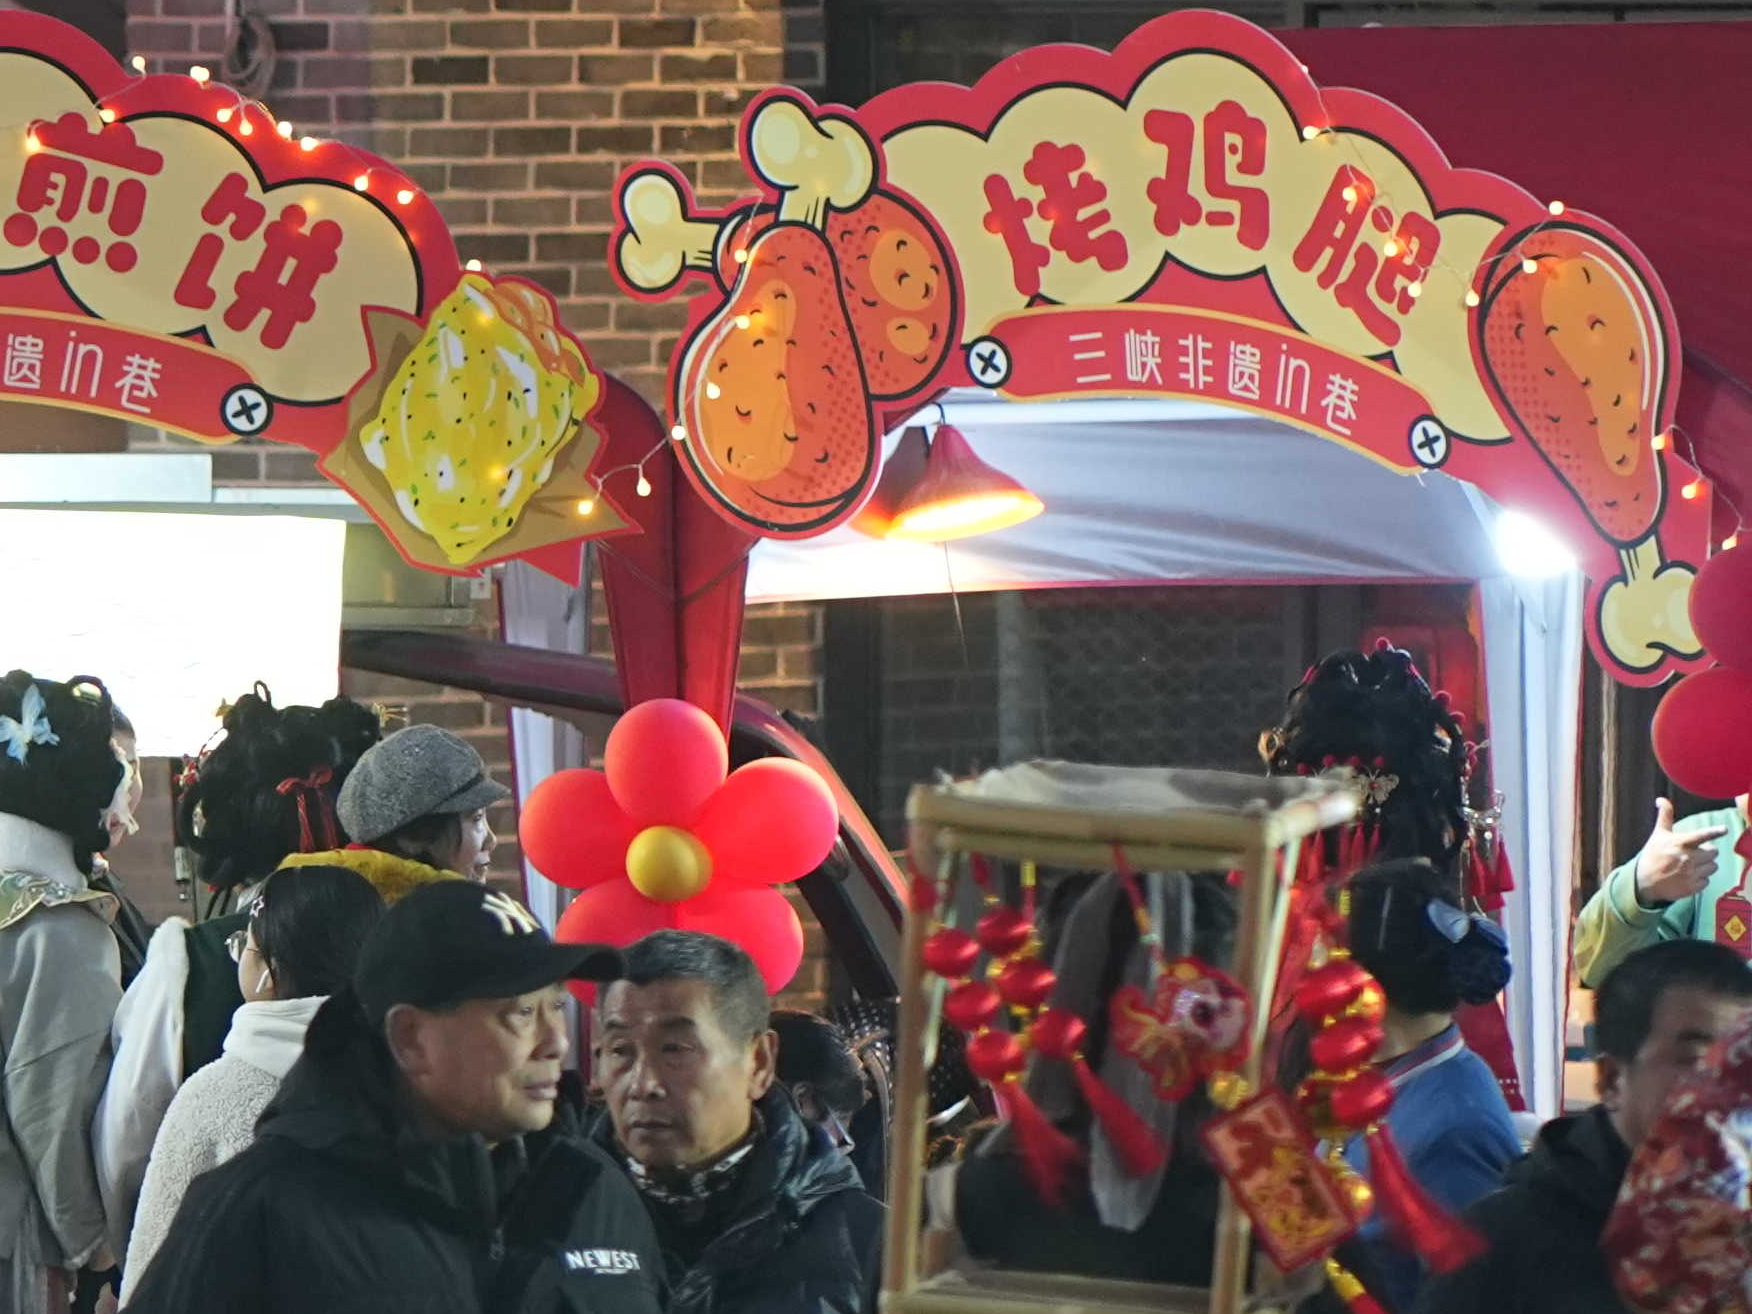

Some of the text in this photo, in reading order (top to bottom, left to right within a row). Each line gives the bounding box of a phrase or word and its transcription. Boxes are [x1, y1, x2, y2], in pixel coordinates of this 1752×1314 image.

[983, 99, 1442, 348] 烤鸡腿
[564, 1248, 642, 1271] NEWEST
